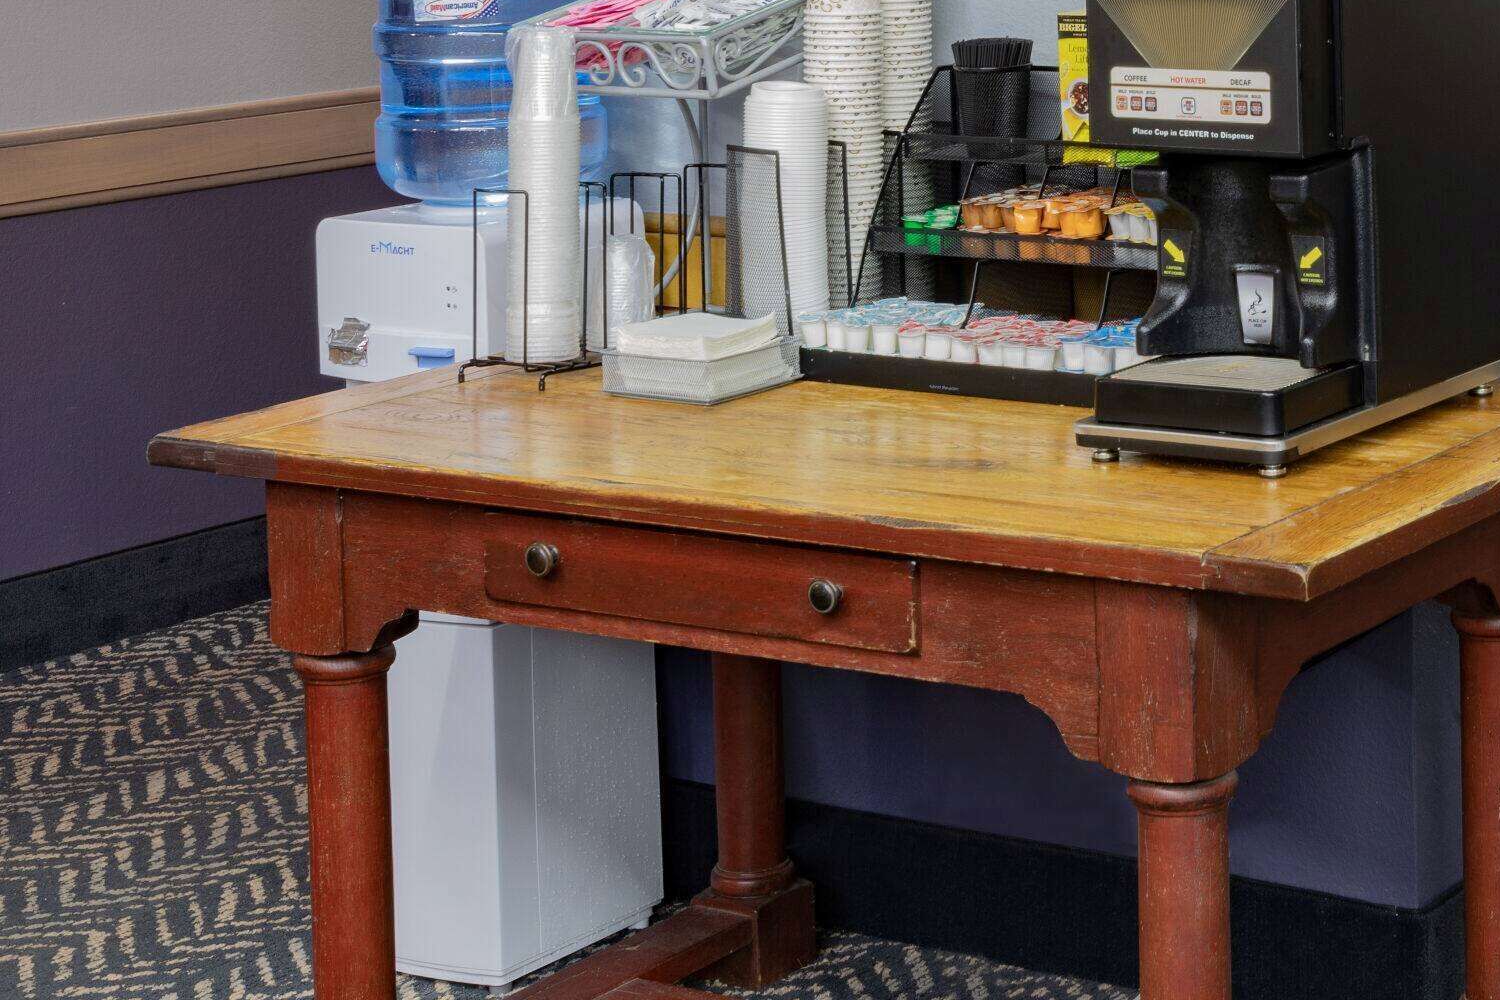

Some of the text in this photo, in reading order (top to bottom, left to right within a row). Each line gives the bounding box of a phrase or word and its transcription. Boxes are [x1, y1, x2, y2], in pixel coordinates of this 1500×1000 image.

[1058, 22, 1087, 32] BIGEL
[1124, 74, 1148, 82] COFFEE
[1185, 76, 1206, 84] WATER
[1230, 78, 1252, 86] DECAF
[1132, 127, 1152, 135] Place
[1154, 128, 1168, 137] Cup
[1178, 129, 1209, 138] CENTER
[1211, 131, 1218, 139] to
[1220, 131, 1254, 140] Dispense
[370, 241, 415, 256] E-MACHT
